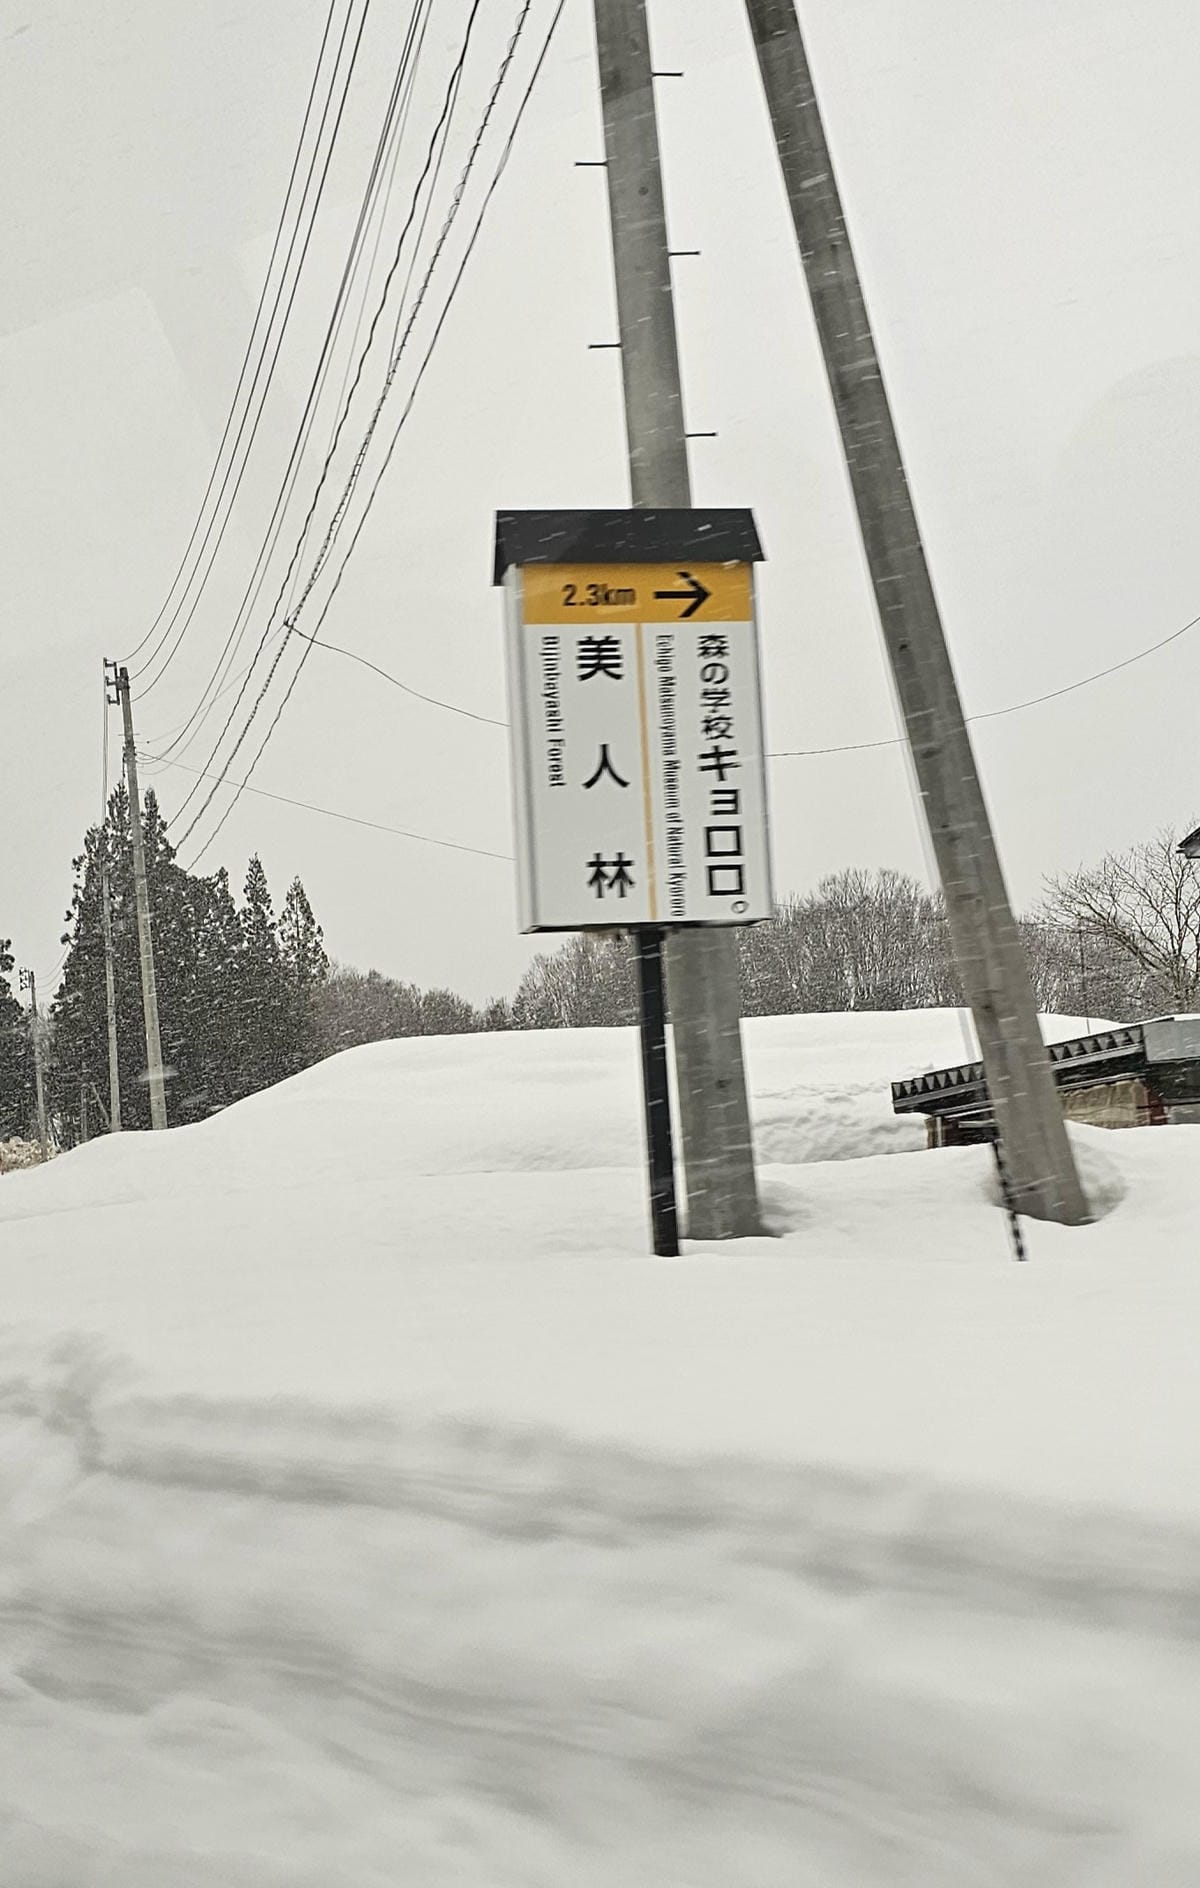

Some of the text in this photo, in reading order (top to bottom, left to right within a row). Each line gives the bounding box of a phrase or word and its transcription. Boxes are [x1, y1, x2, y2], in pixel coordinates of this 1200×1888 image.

[562, 583, 637, 608] 2.3km
[654, 634, 677, 672] Echigo
[546, 738, 567, 788] Forest
[576, 634, 636, 899] 美人林
[663, 760, 683, 809] Museum
[666, 812, 684, 824] of
[667, 827, 687, 869] Natural
[665, 873, 689, 917] Kyororo
